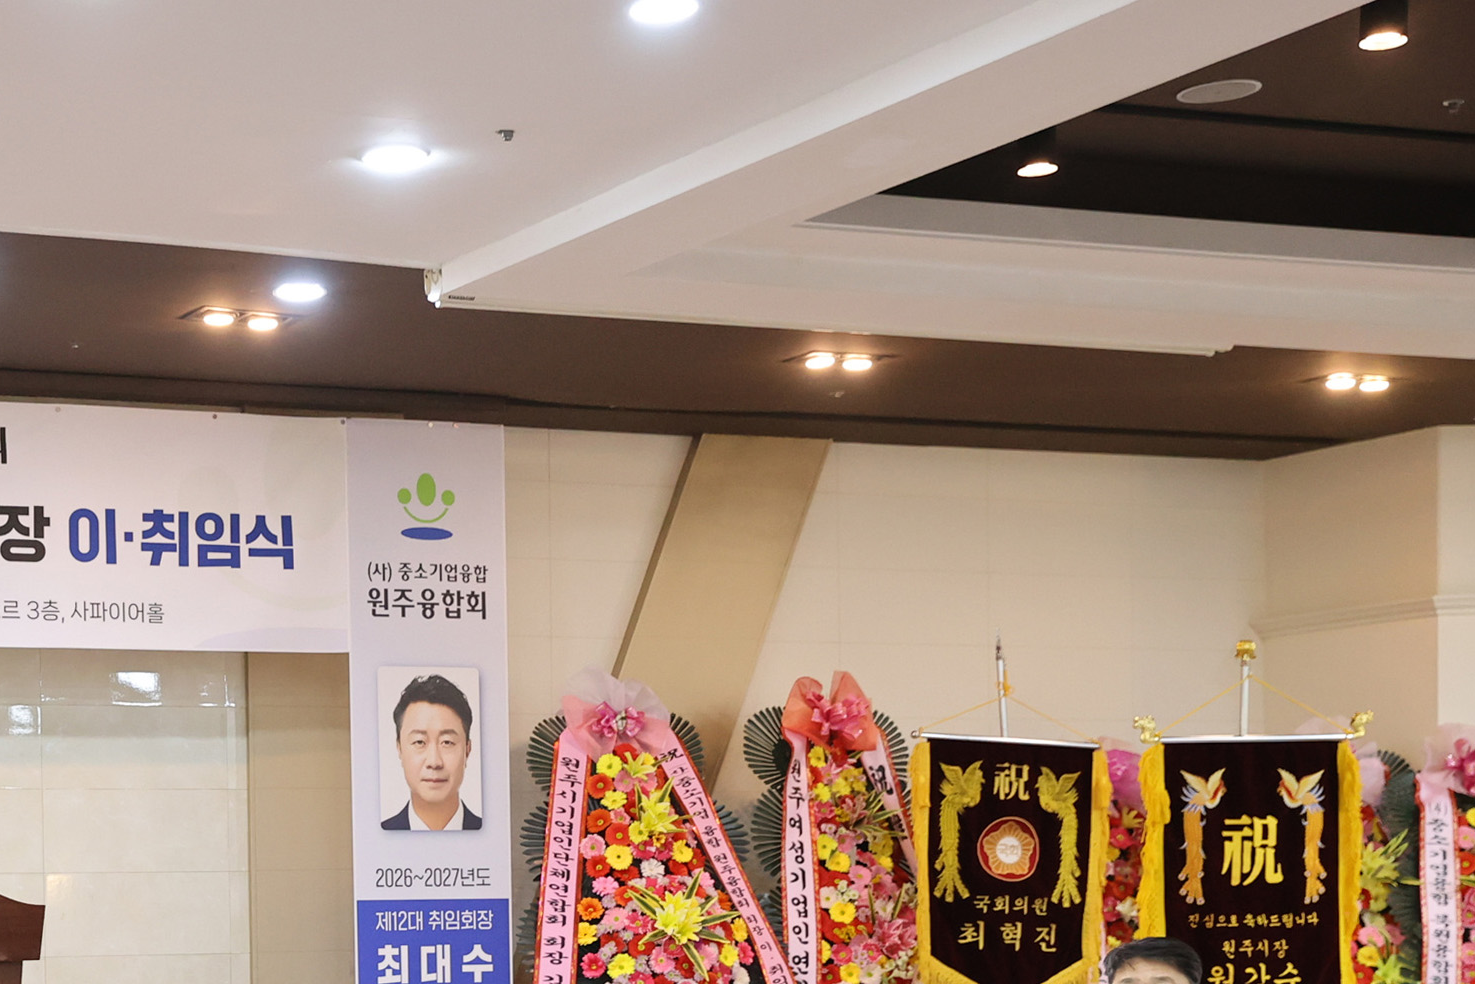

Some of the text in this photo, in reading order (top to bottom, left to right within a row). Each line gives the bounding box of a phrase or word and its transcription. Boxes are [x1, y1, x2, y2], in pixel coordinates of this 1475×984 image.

[68, 508, 295, 570] 이·취임식
[367, 562, 488, 583] (사) 중소기업융합
[27, 598, 66, 624] 3층,
[70, 600, 165, 625] 사파이어홀
[367, 588, 486, 620] 원주융합회
[993, 762, 1031, 801] 祝
[1221, 814, 1284, 886] 祝
[375, 868, 491, 888] 2026~2027년도
[974, 895, 1049, 916] 국회의원
[375, 910, 493, 932] 제12대 취임회장
[544, 936, 569, 966] 회장
[1222, 938, 1290, 959] 원주시장
[377, 944, 494, 984] 최대수
